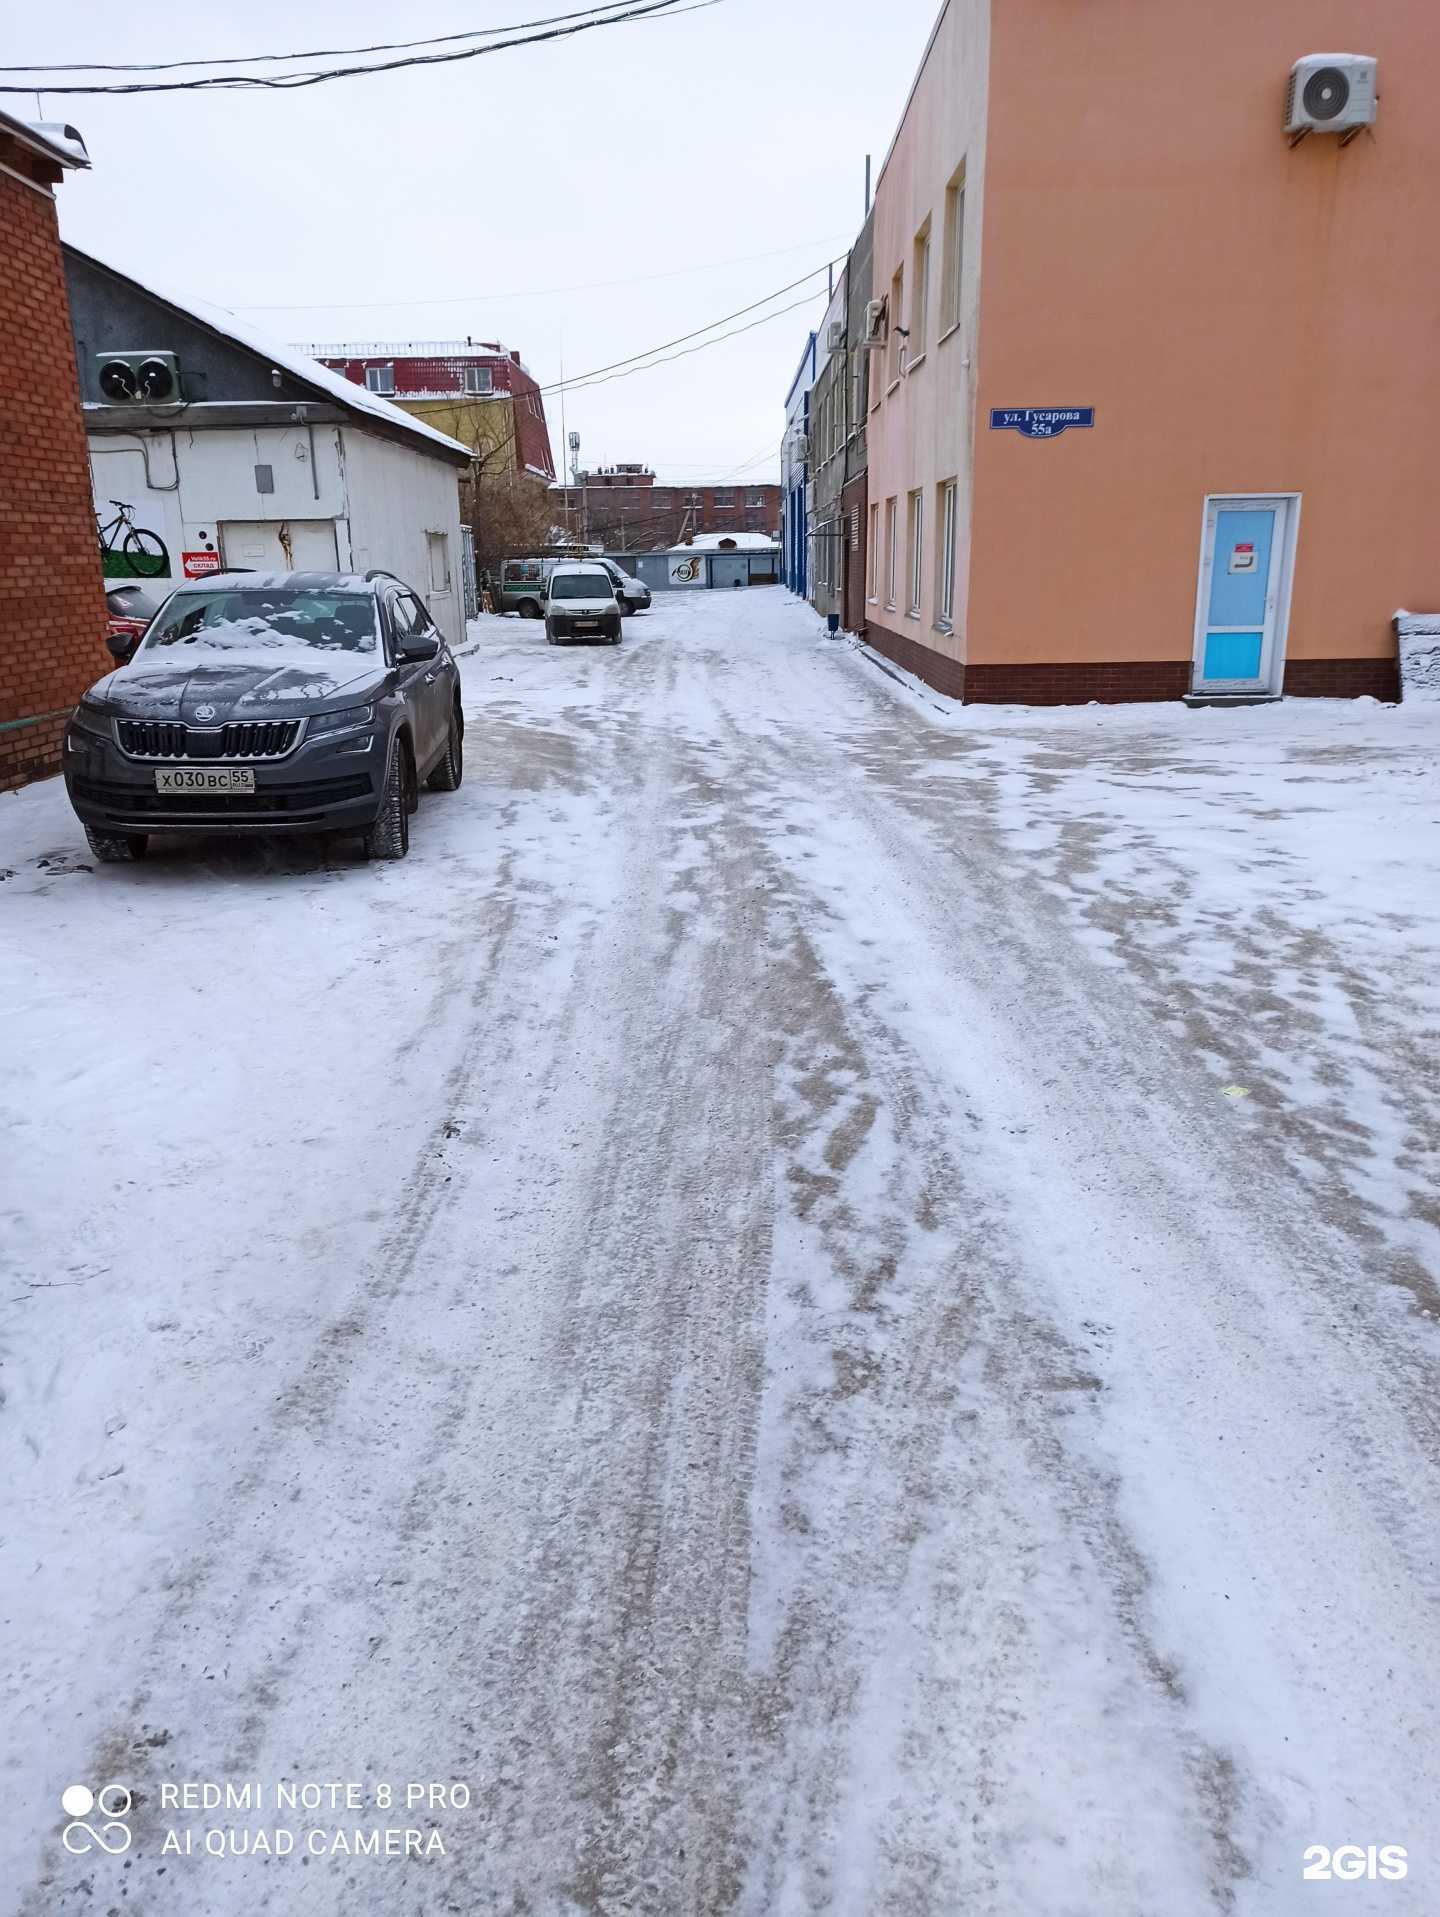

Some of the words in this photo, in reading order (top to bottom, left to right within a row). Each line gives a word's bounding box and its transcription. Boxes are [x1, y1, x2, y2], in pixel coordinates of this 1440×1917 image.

[1003, 413, 1022, 425] ул.
[1025, 410, 1080, 424] Гусарова
[1031, 423, 1052, 435] 55а
[232, 771, 249, 783] 55
